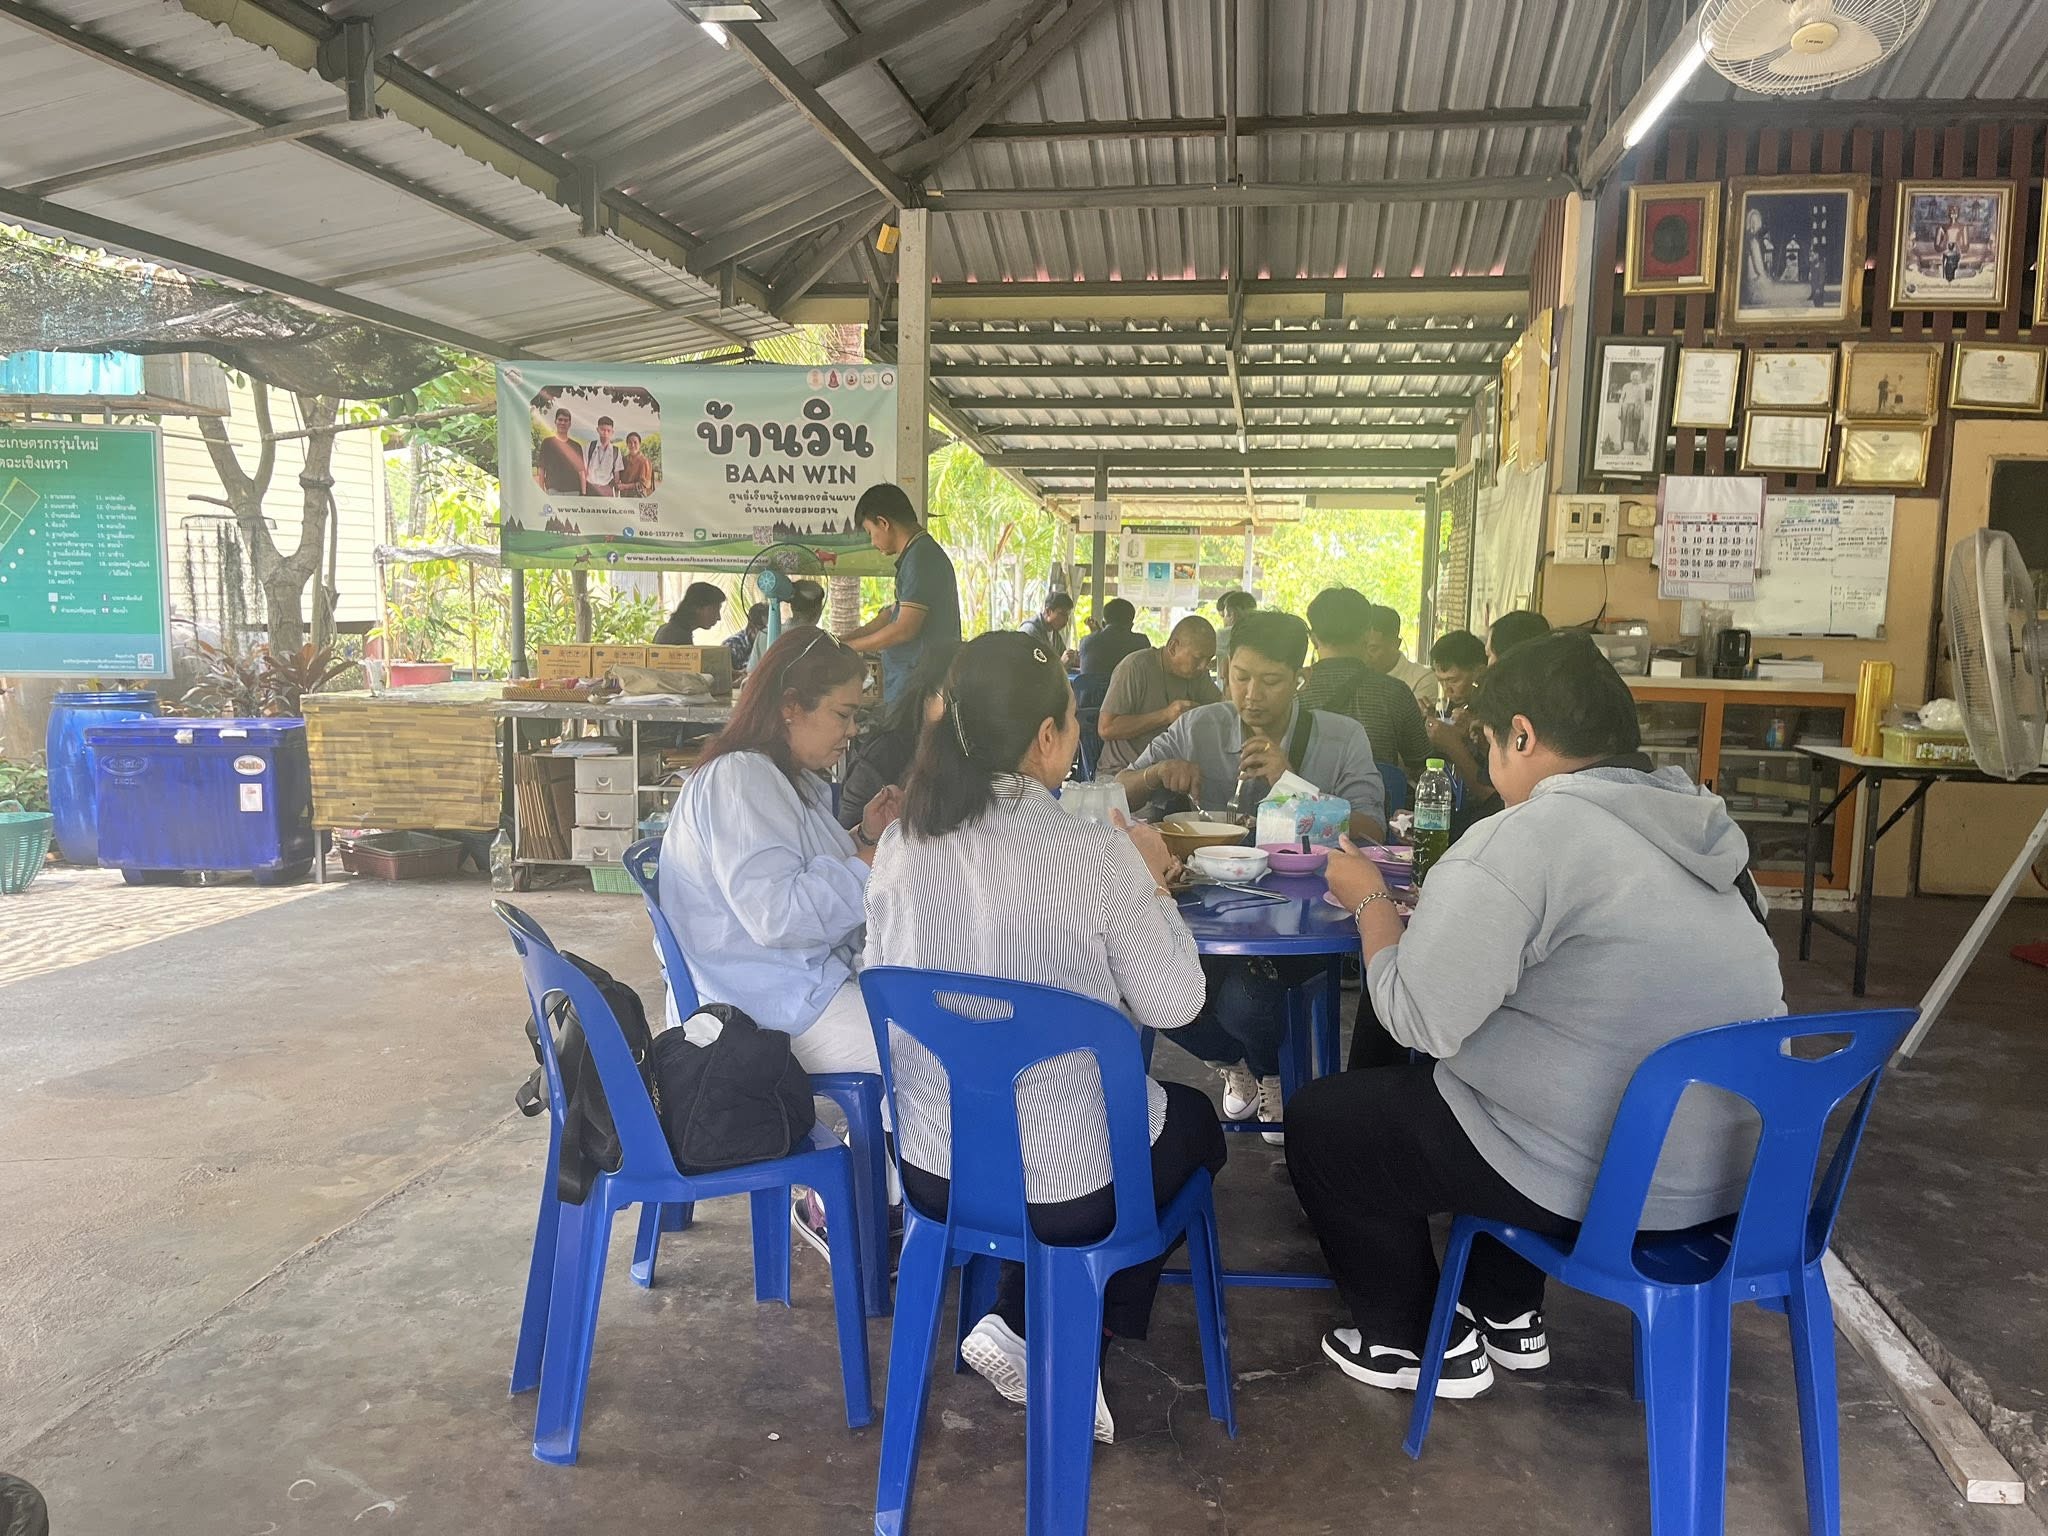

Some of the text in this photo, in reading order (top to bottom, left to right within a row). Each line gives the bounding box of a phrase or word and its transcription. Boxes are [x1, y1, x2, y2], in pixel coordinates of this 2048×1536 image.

[696, 399, 874, 458] บ้านวิน
[726, 464, 856, 484] BAAN WIN
[557, 507, 635, 515] www.baanwin.com
[237, 760, 262, 769] Safe
[1520, 1332, 1546, 1351] PUM
[1471, 1351, 1488, 1374] PU
